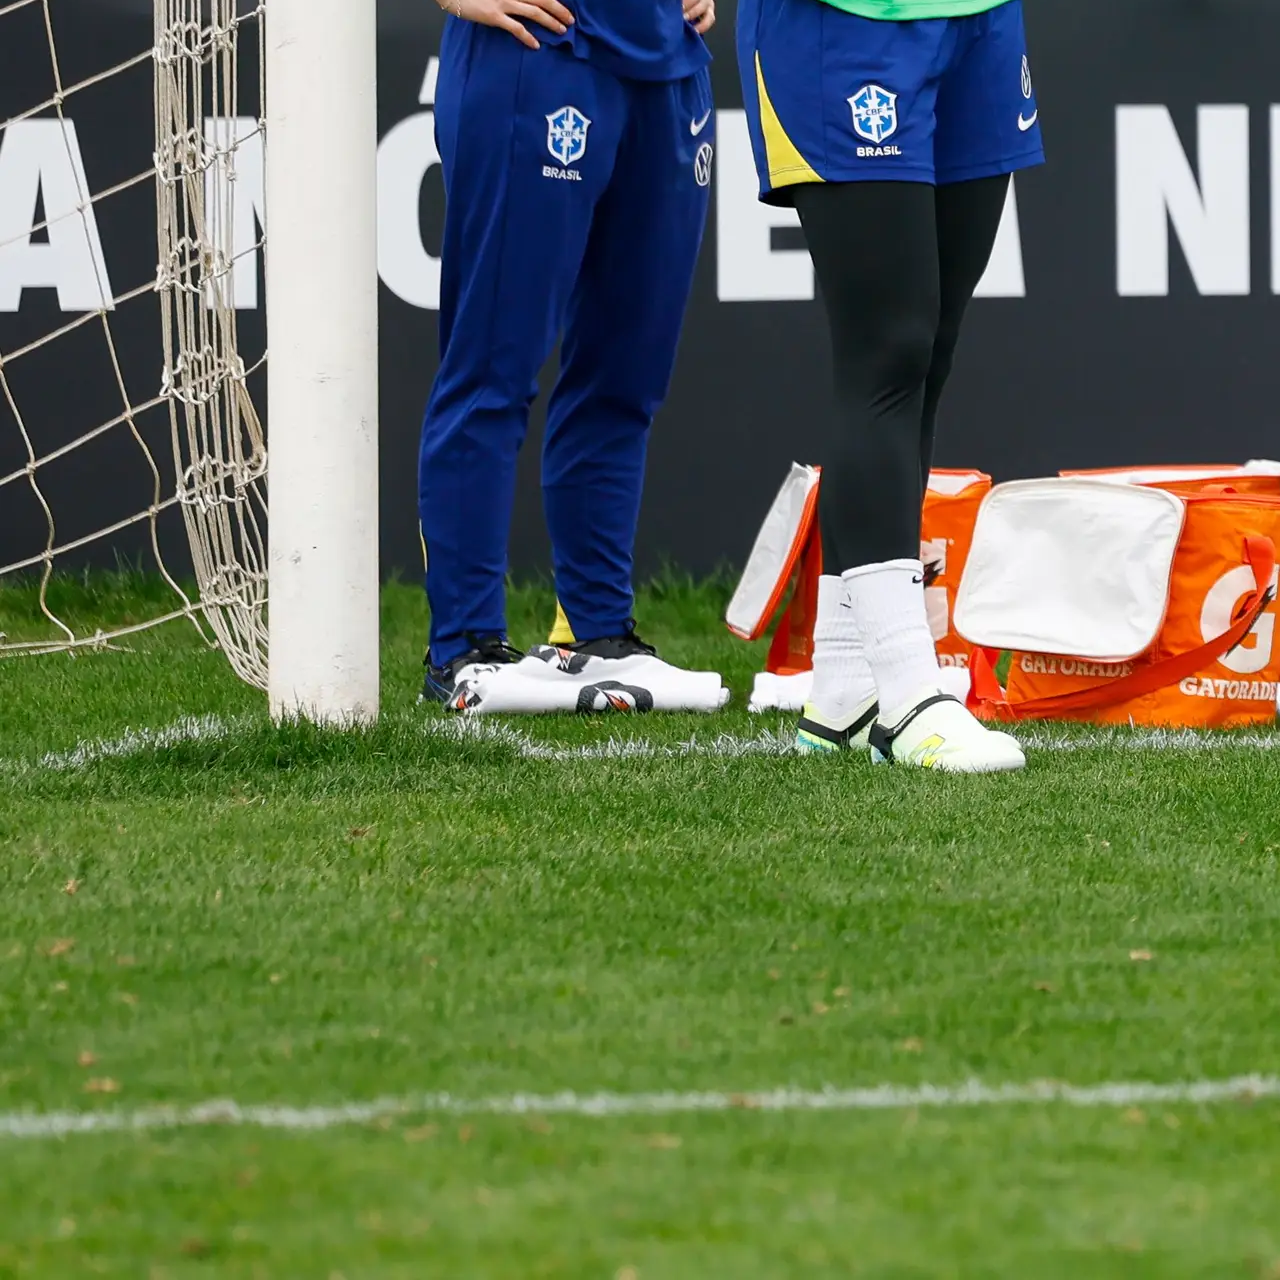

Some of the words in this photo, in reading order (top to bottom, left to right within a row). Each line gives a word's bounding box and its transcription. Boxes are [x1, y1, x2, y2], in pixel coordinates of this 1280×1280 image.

[856, 144, 902, 158] BRASIL
[542, 165, 583, 181] BRASIL
[1019, 653, 1133, 678] GATORADE
[1180, 676, 1277, 702] GATORADE
